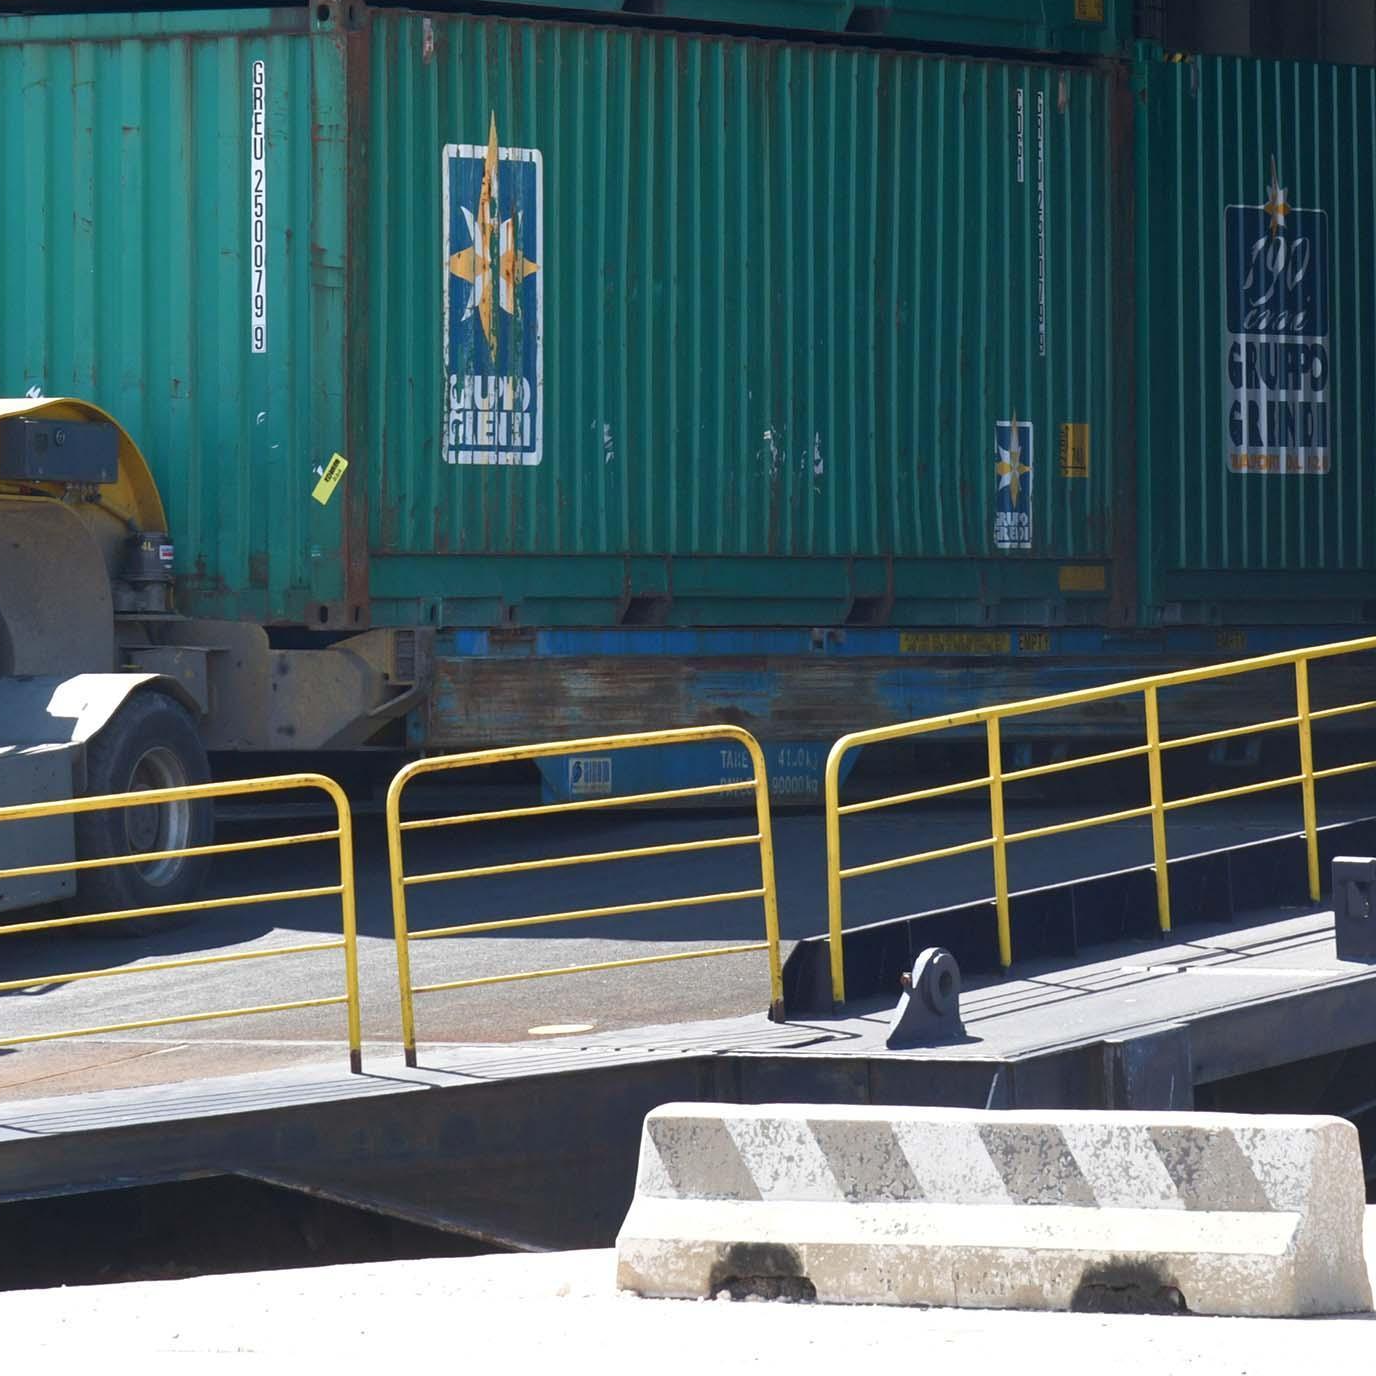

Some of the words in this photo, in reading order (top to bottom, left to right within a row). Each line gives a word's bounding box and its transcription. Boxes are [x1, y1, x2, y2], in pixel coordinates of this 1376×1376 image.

[253, 62, 264, 161] GREU
[254, 169, 265, 318] 250079
[254, 326, 265, 350] 9
[1228, 341, 1329, 392] GRUPPO
[1228, 399, 1328, 448] GRENDI
